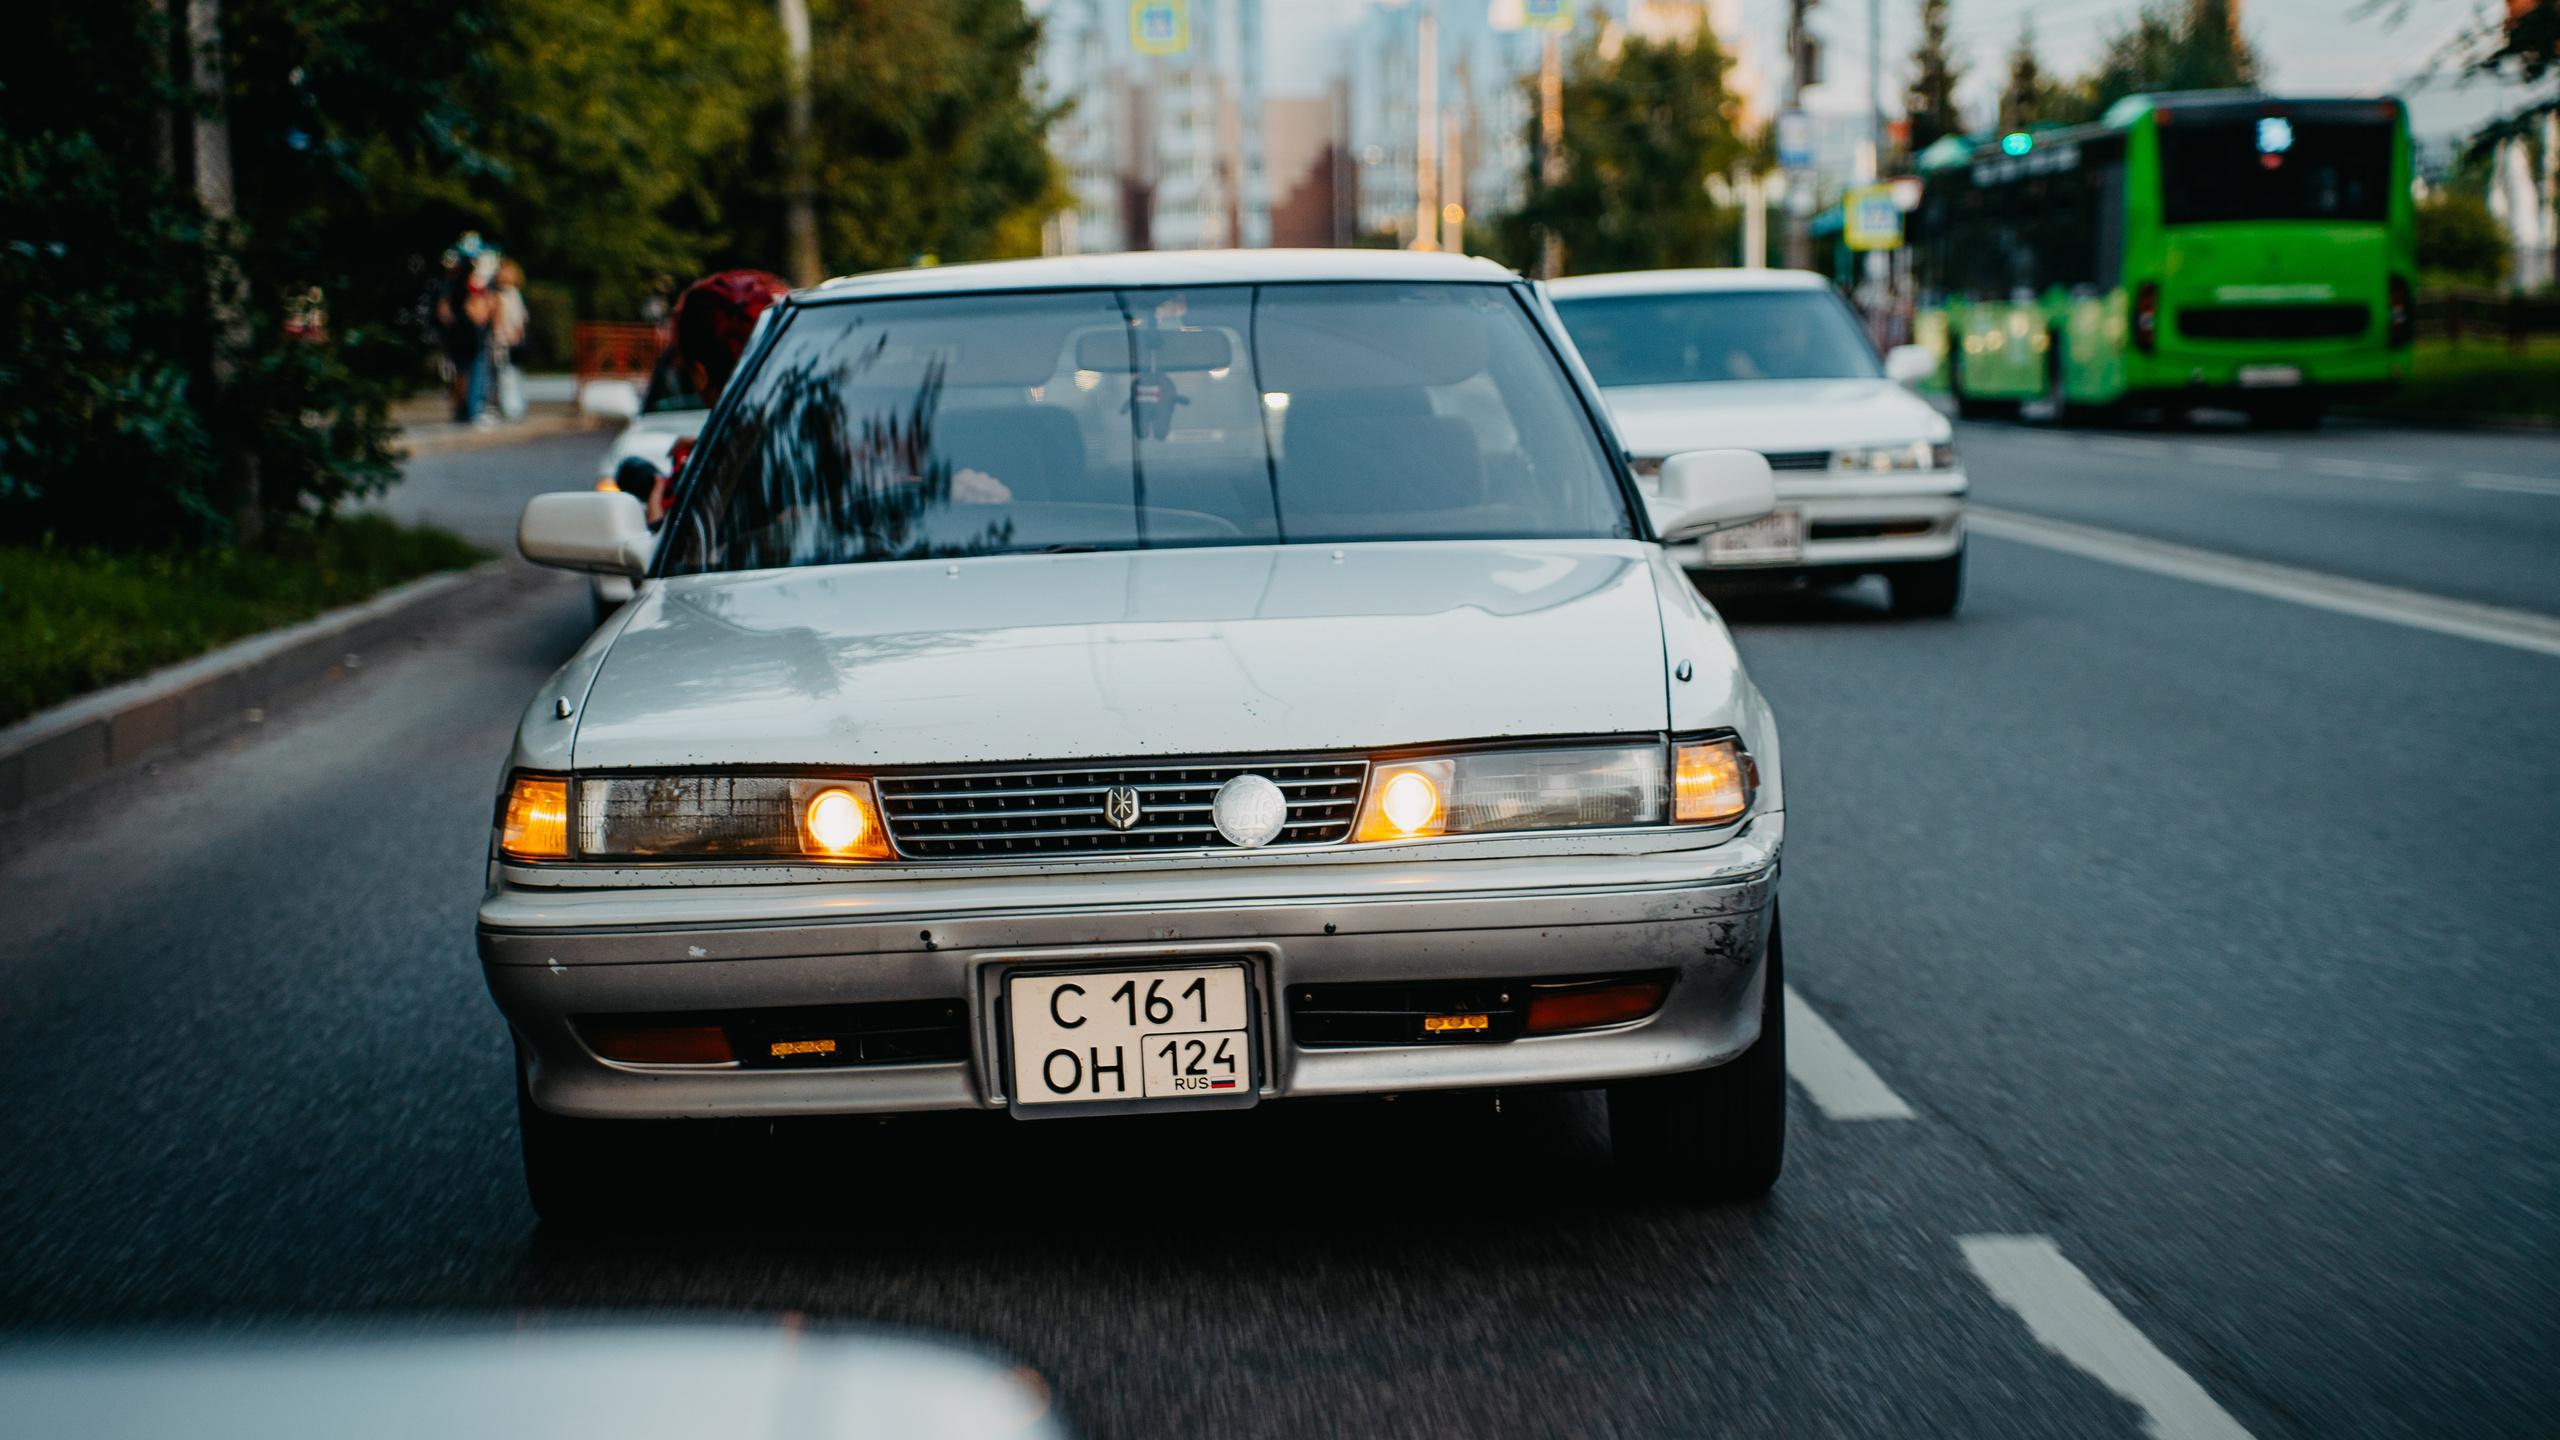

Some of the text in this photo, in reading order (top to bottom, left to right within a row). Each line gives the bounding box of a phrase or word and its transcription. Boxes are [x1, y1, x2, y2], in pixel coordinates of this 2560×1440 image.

[1111, 977, 1207, 1027] 161
[1158, 1037, 1236, 1077] 124
[1174, 1076, 1210, 1091] RUS
